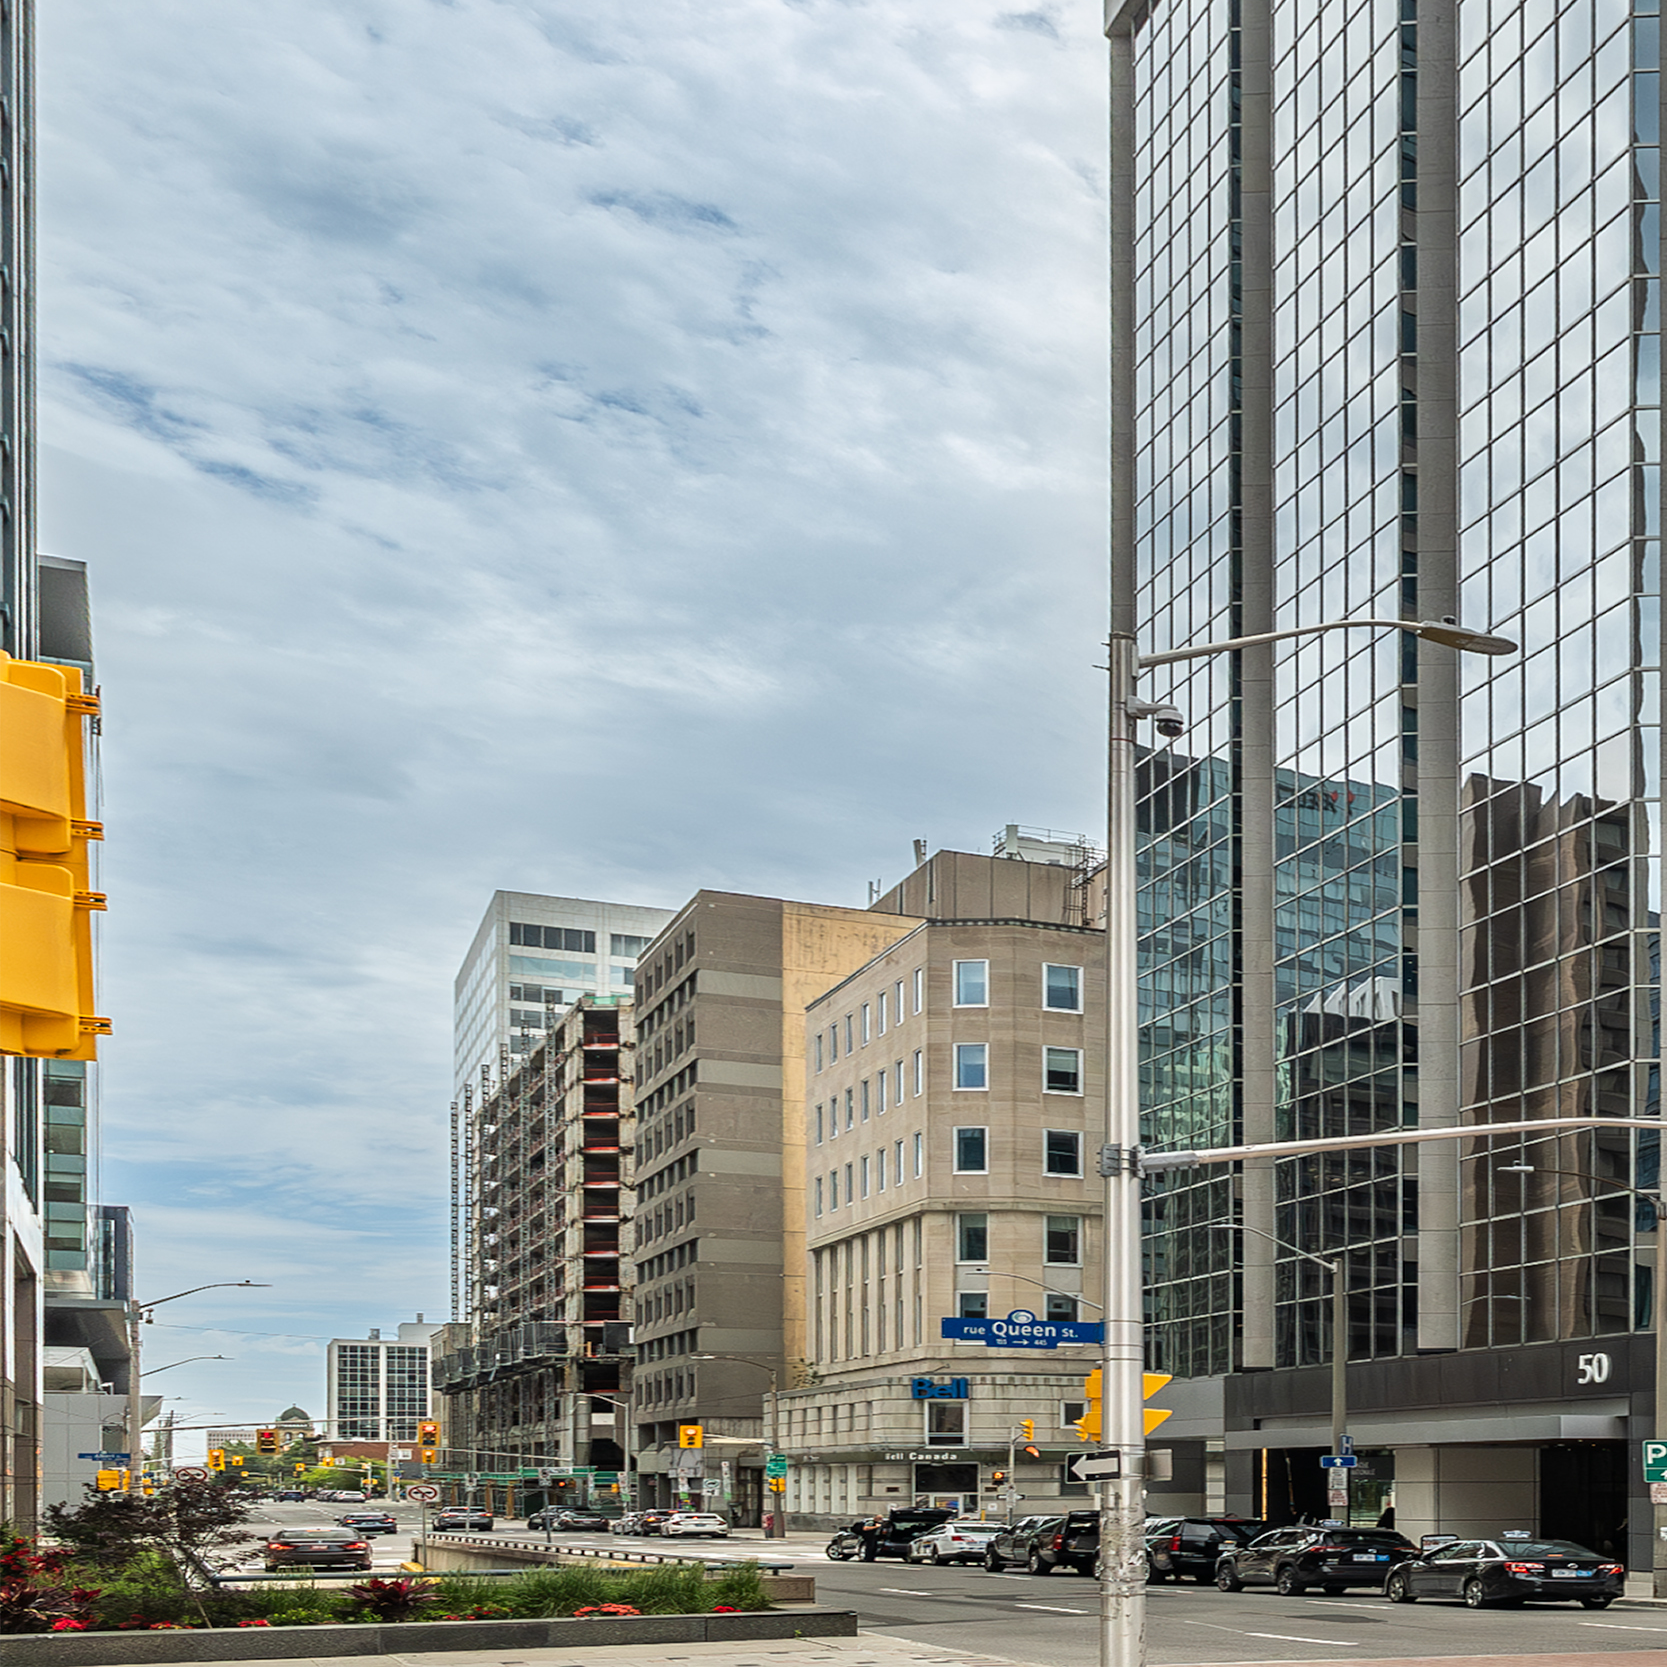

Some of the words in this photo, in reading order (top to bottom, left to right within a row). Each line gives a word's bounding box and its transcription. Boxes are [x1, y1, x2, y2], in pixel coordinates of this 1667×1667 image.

[963, 1326, 985, 1335] rue
[992, 1321, 1056, 1337] Queen
[1061, 1327, 1079, 1337] St.
[1577, 1352, 1609, 1384] 50
[912, 1377, 969, 1399] Bell
[1341, 1436, 1353, 1455] H
[1646, 1444, 1667, 1464] P
[908, 1452, 958, 1461] Canada
